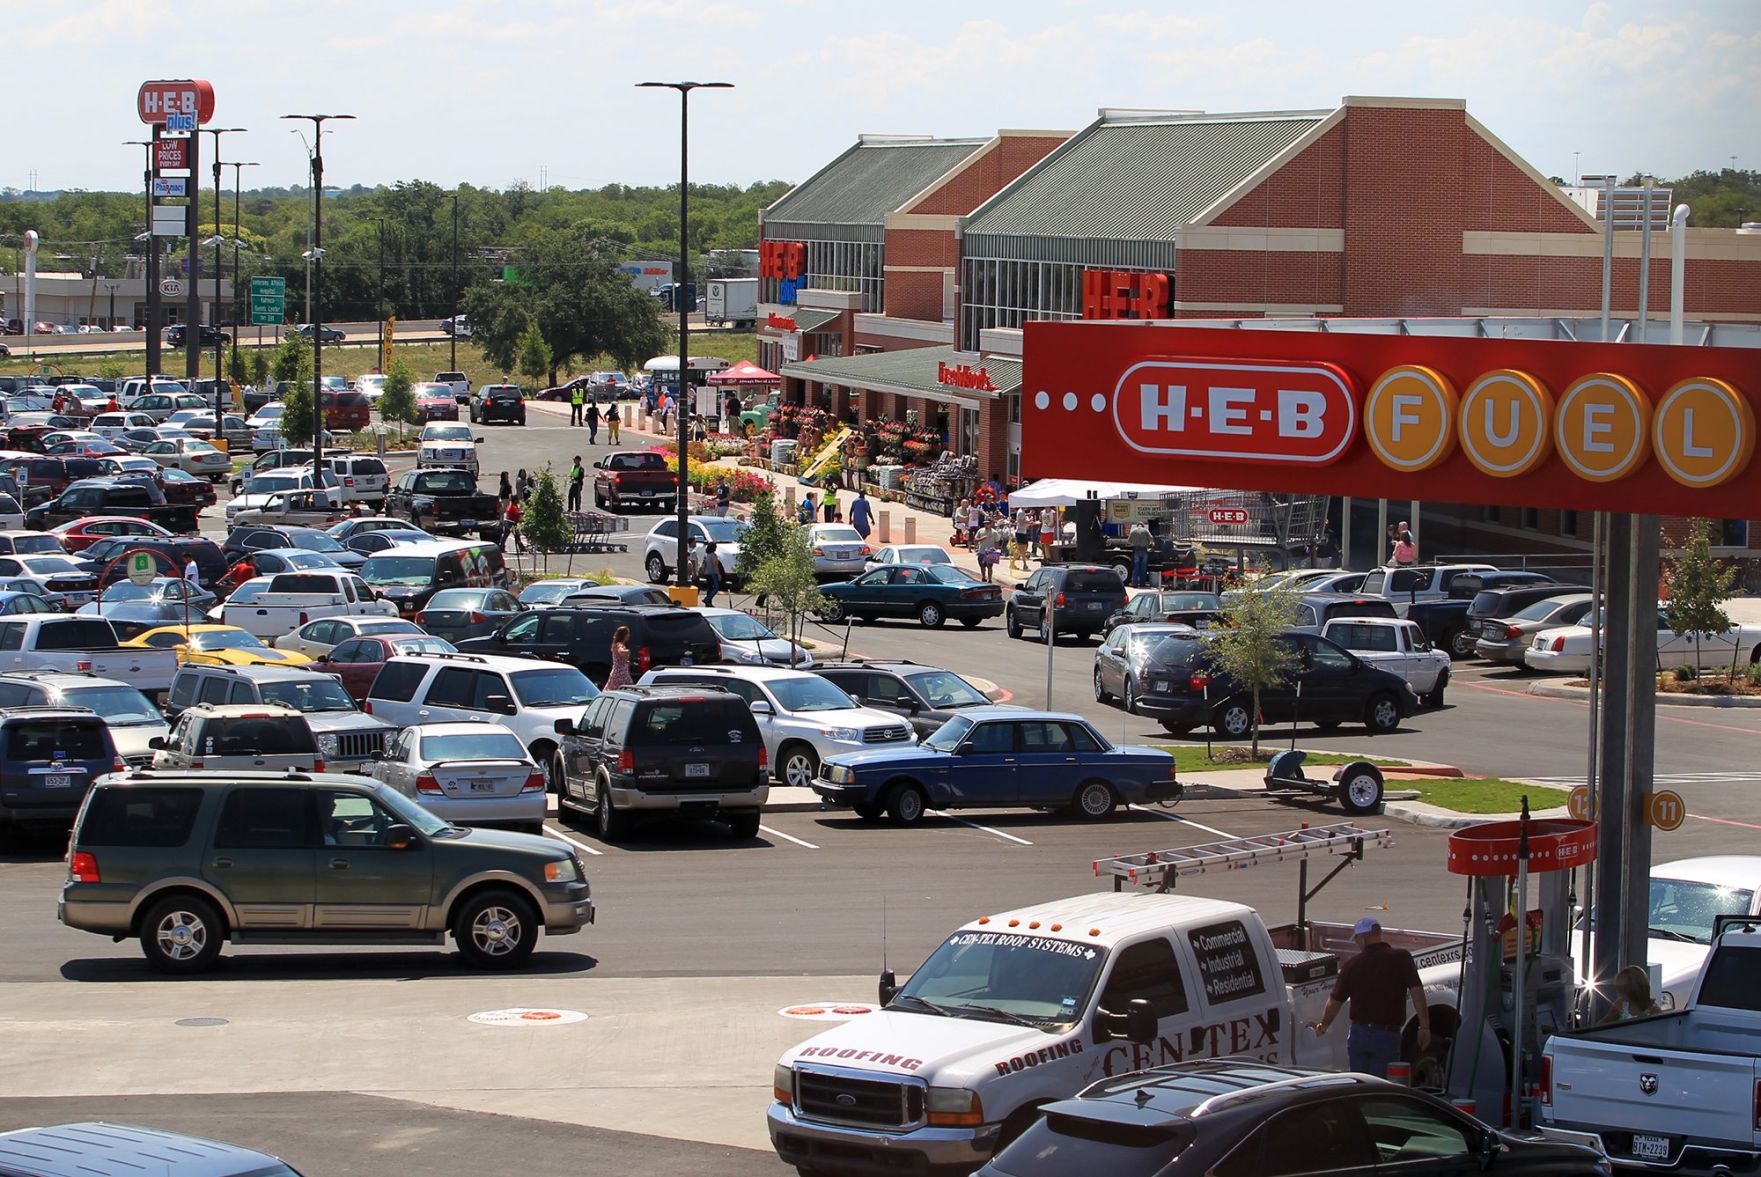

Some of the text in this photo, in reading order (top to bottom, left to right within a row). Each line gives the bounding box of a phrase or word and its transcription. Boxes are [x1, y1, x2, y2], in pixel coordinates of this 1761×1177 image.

[167, 111, 196, 134] plus!
[159, 151, 181, 160] PRICES
[1140, 383, 1328, 440] H-E-B
[1213, 512, 1245, 521] H-E-B
[1660, 800, 1676, 820] 11
[958, 934, 1084, 958] CEN-TEX ROOF SYSTEMS
[1200, 926, 1246, 951] Commercial
[1206, 950, 1244, 973] Industrial
[1213, 970, 1256, 995] Residential
[800, 1047, 922, 1070] ROOFING
[995, 1039, 1083, 1076] ROOFING
